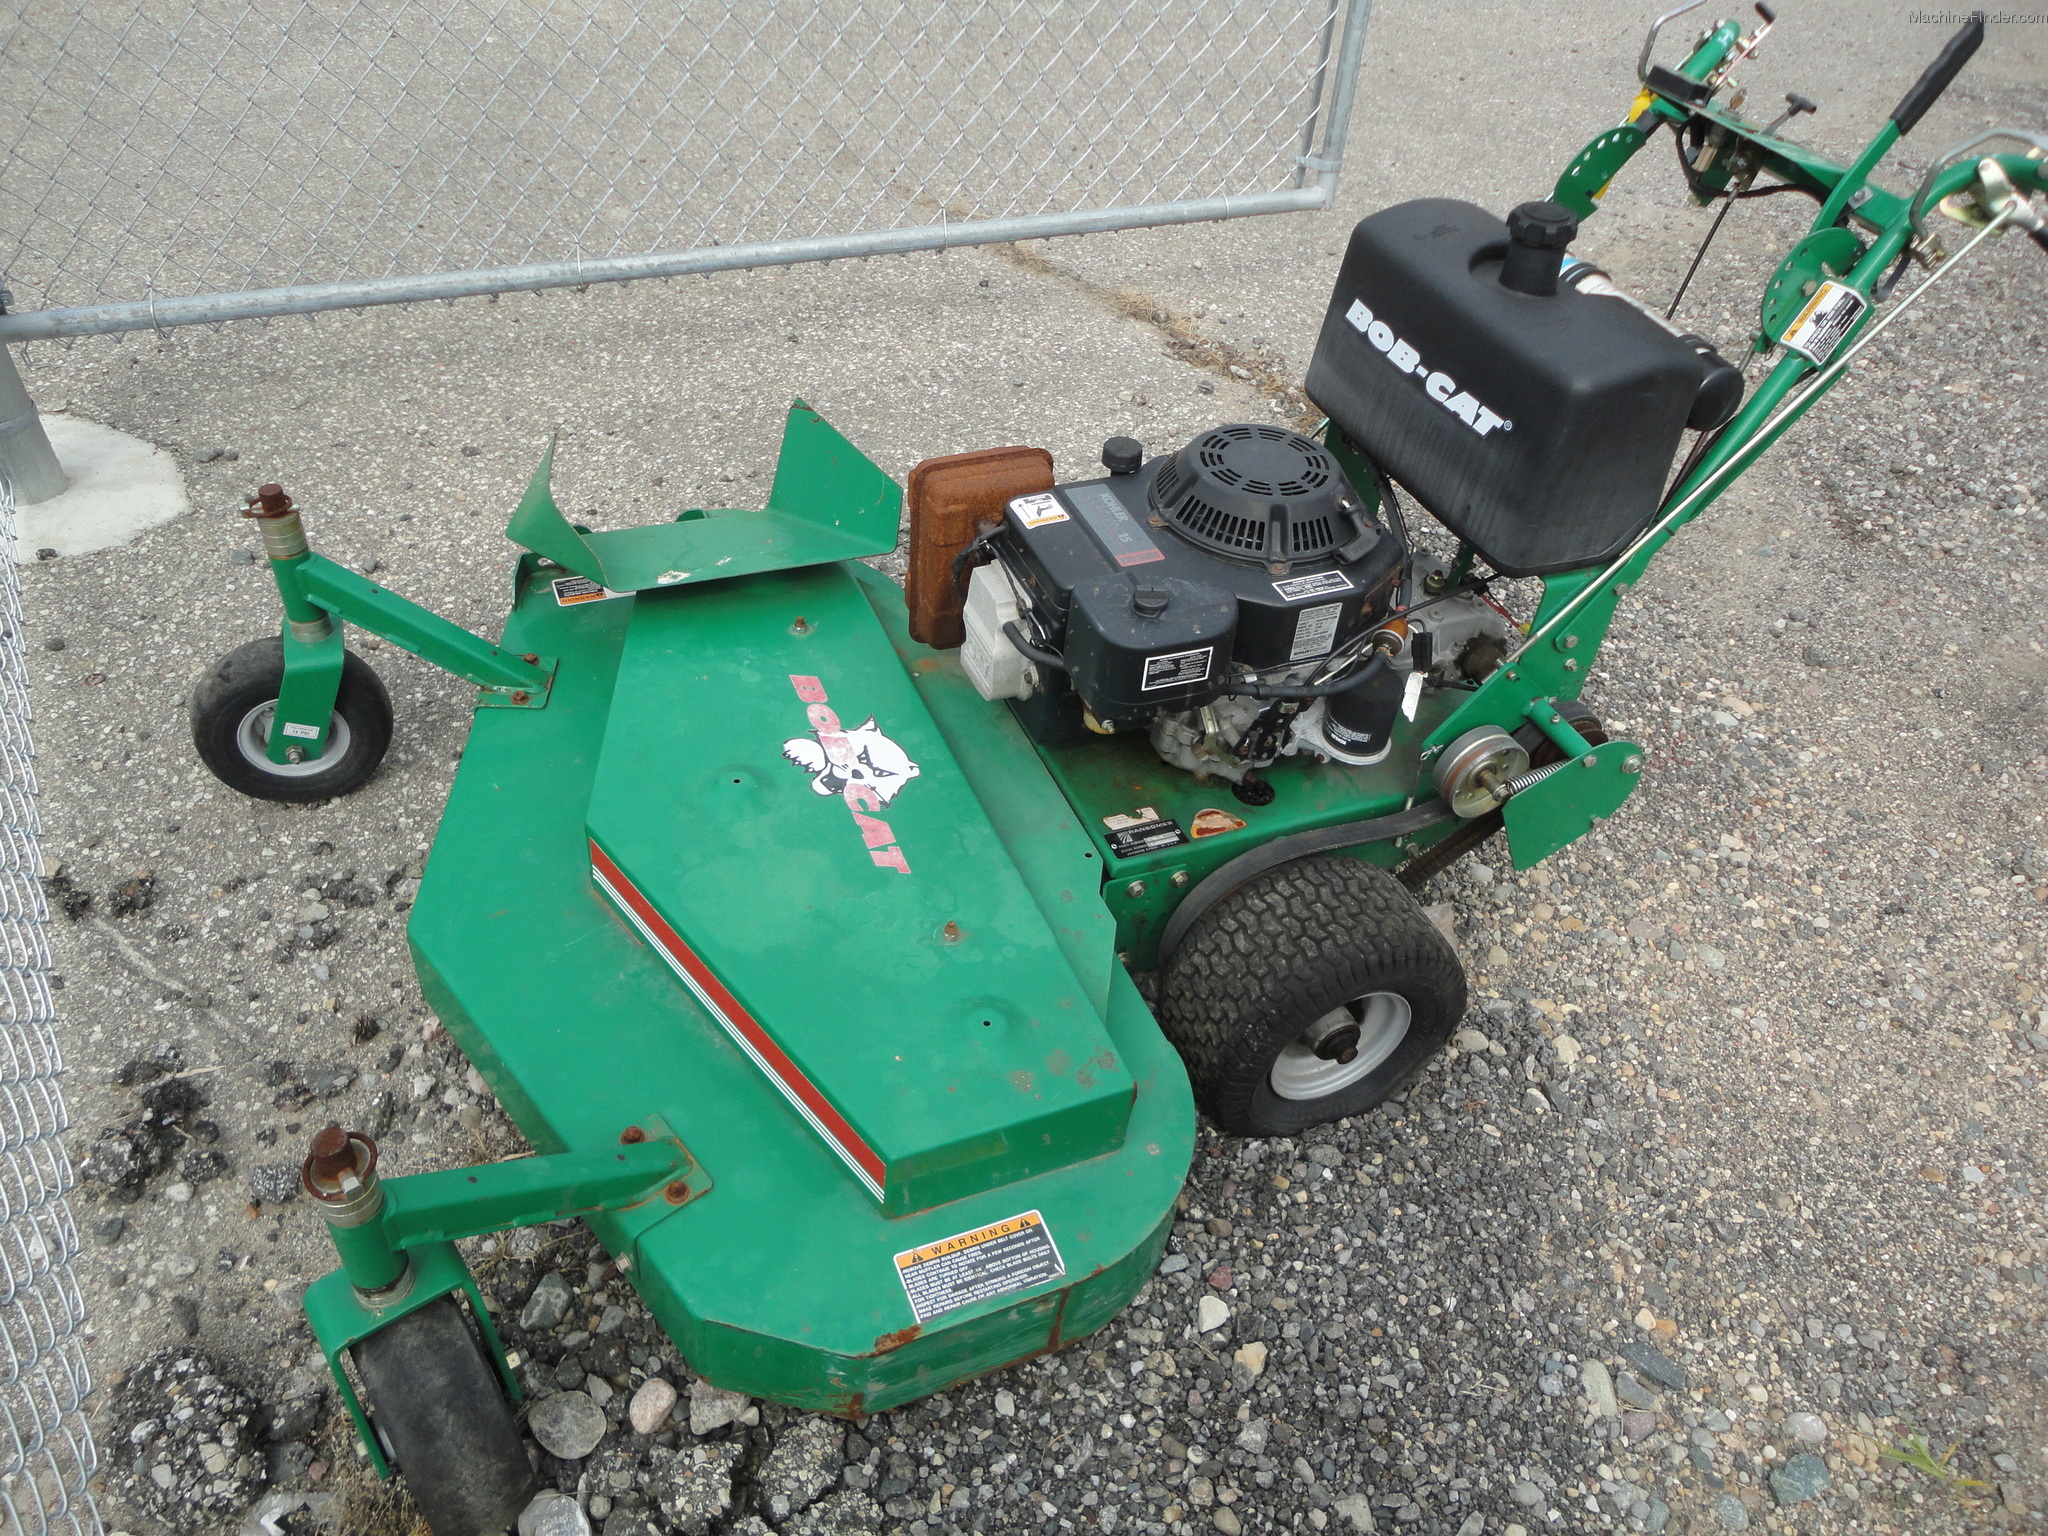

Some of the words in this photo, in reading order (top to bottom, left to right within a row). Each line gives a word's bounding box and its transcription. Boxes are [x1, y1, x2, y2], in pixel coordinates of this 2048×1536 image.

[1346, 299, 1504, 437] BOB-CAT
[1098, 493, 1129, 522] KOHLER
[1116, 533, 1133, 543] 15
[562, 594, 596, 603] WARNING
[1128, 821, 1173, 835] RANSOMES
[931, 1224, 1011, 1256] WARNING
